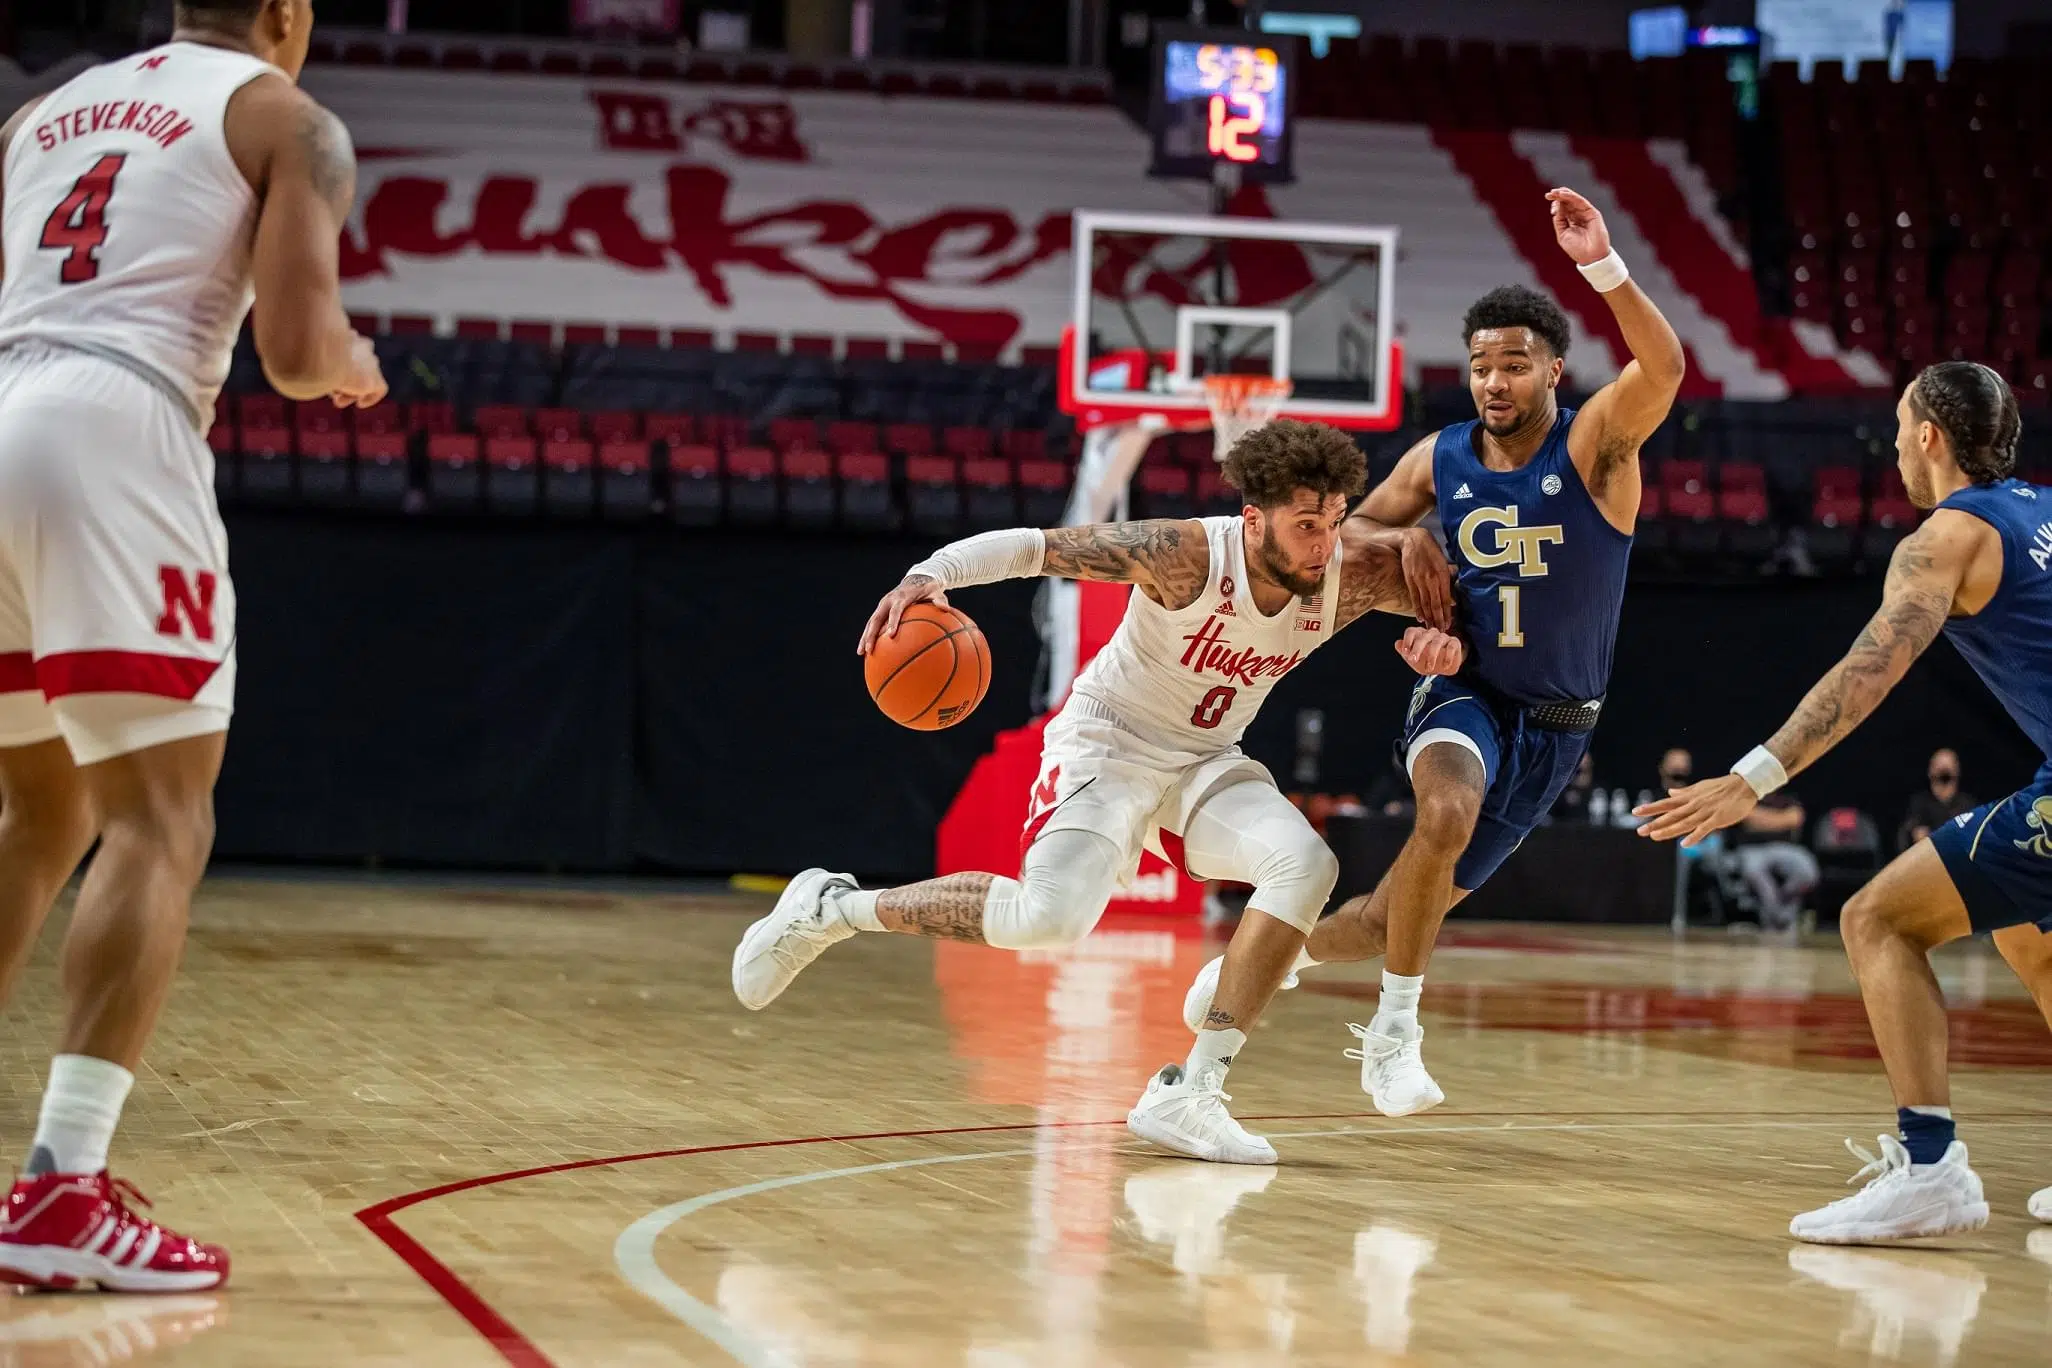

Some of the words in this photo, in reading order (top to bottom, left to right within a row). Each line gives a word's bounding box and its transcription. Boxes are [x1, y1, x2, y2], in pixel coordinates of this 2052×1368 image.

[36, 100, 195, 153] STEVENSON
[1208, 93, 1264, 161] 12
[38, 151, 129, 284] 4
[1458, 505, 1564, 577] GT
[2028, 521, 2052, 572] ALV
[155, 563, 218, 642] N
[1214, 608, 1237, 617] adidas
[1498, 585, 1524, 648] 1
[1180, 615, 1305, 686] Huskers
[1190, 685, 1237, 729] 0
